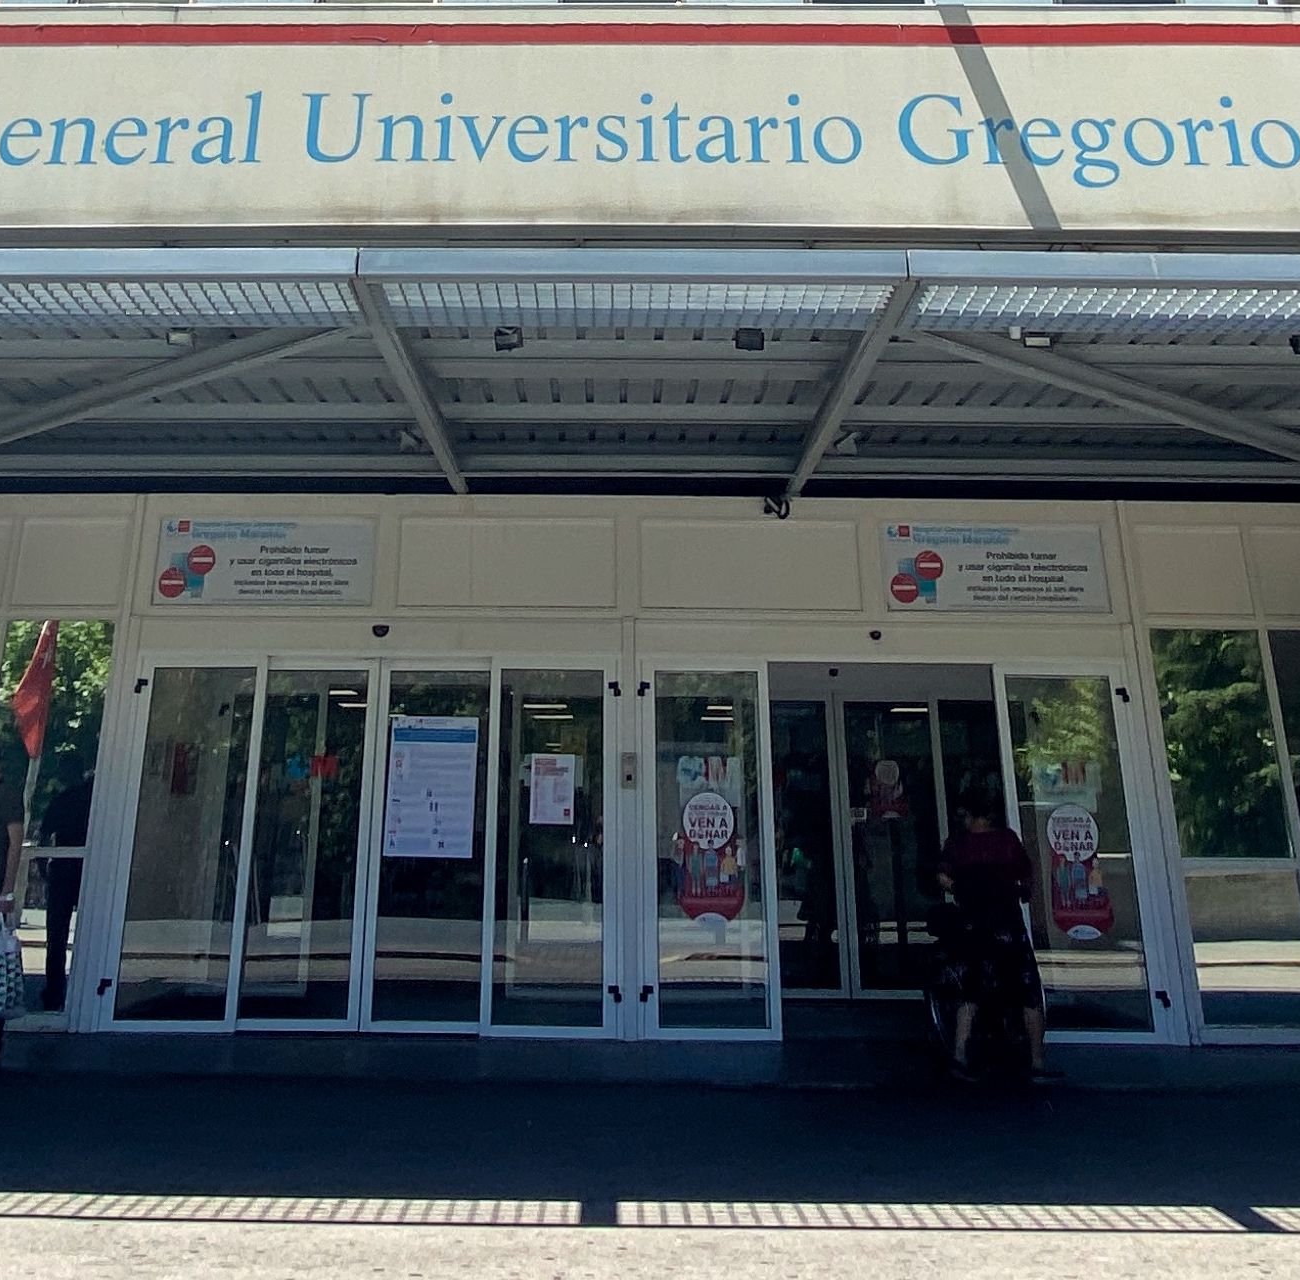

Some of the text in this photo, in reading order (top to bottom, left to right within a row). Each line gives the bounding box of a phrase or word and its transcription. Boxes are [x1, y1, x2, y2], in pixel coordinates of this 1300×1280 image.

[303, 92, 863, 166] Universitario
[260, 545, 330, 554] Prohibido fumar
[986, 551, 1057, 560] Prohibido fumar
[689, 817, 728, 829] VEN A
[1053, 830, 1093, 841] VEN A
